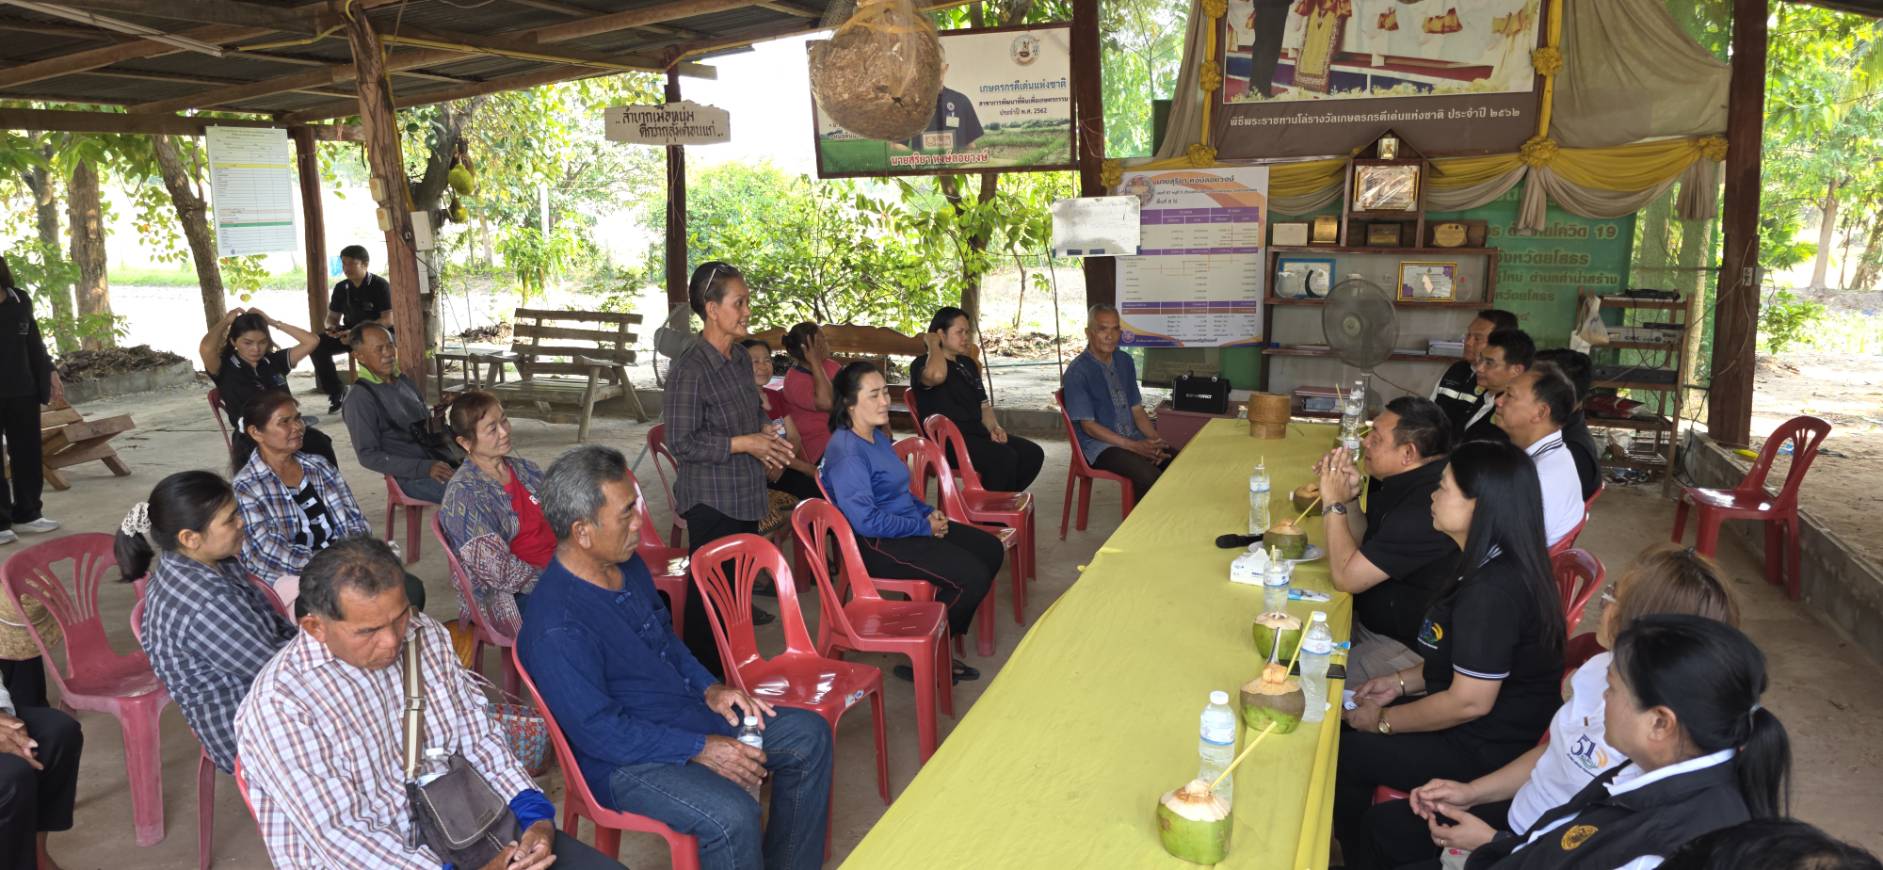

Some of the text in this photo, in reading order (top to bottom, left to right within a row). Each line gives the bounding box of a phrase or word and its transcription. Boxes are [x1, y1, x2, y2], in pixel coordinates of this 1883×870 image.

[979, 77, 1067, 93] เกษตรกรดีเด่นแห่งชาติ
[1230, 109, 1444, 126] พิธีพระราชทานโล่รางวัลเกษตรกรดีเด่นแห่งชาติ
[1448, 107, 1486, 119] ประจำปี
[890, 151, 931, 168] นายสุริยา
[1596, 224, 1617, 239] 19
[1570, 734, 1596, 760] 51
